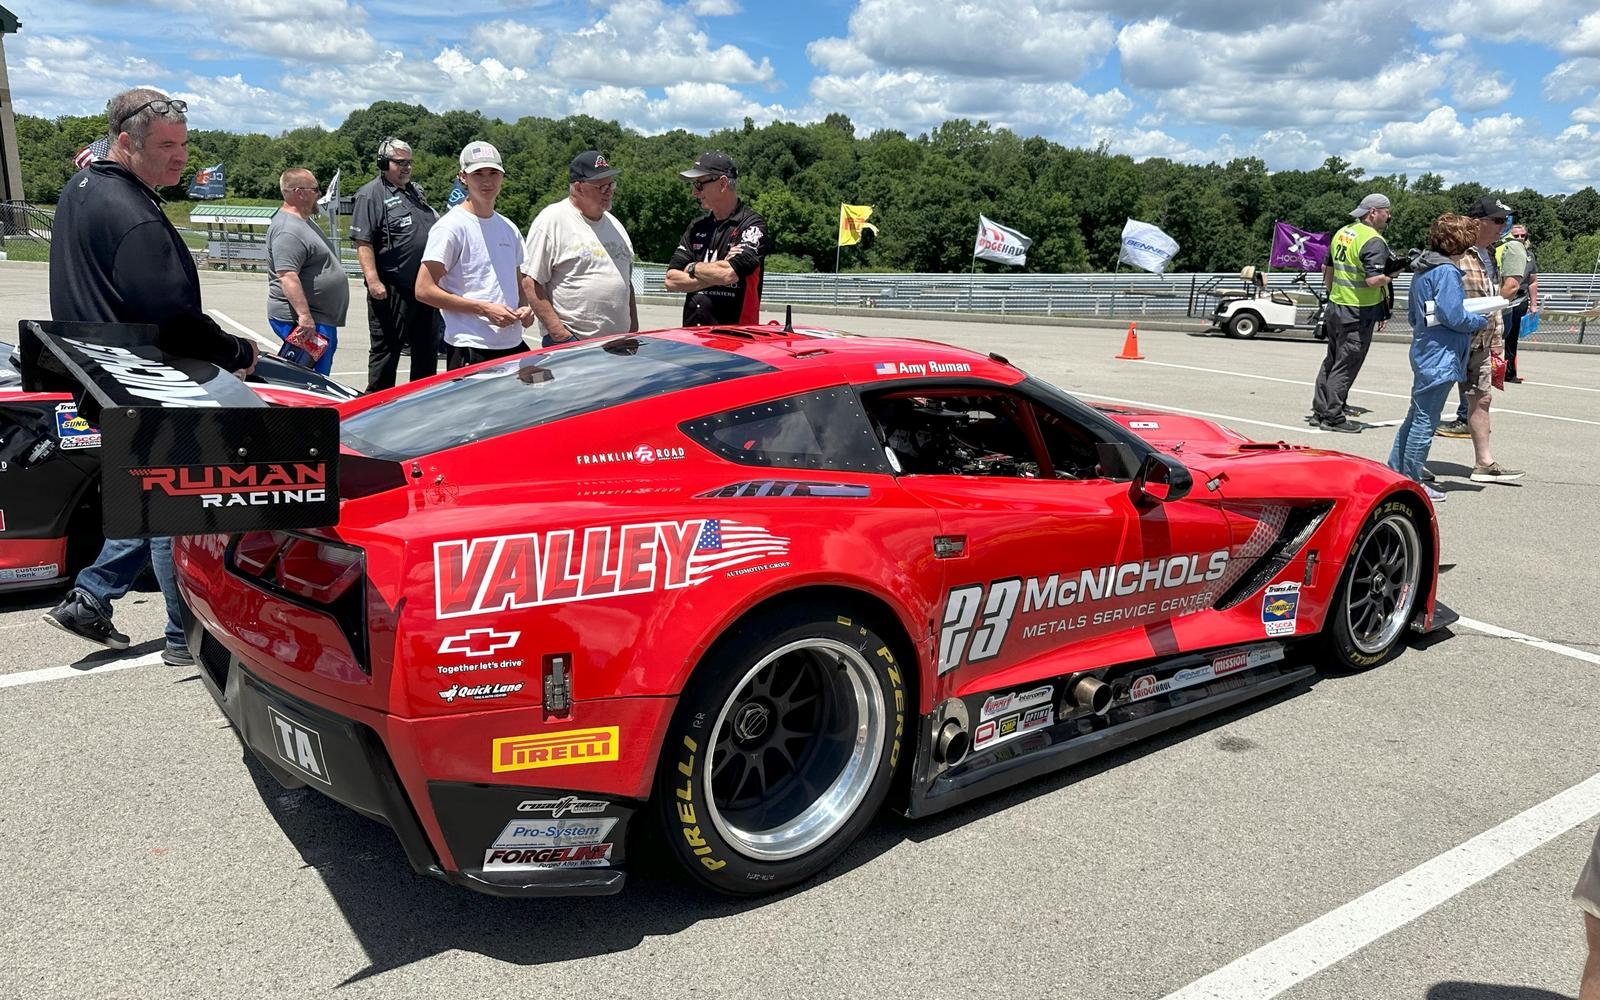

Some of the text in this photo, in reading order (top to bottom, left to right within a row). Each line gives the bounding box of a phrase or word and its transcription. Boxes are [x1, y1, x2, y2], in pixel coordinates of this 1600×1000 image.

[899, 361, 971, 377] Amy Ruman
[576, 450, 634, 465] FRANKLIN
[655, 447, 685, 458] ROAD
[139, 463, 326, 496] RUMAN
[200, 489, 326, 508] RACING
[433, 519, 706, 620] VALLEY
[725, 561, 791, 578] AUTOMOTIVE GROUP
[1022, 550, 1229, 613] McNICHOLS
[1023, 592, 1213, 640] METALS SERVICE CENTER
[437, 659, 522, 675] Together let's drive
[1215, 655, 1247, 672] MISSION
[458, 684, 493, 698] Quick
[492, 682, 523, 694] Lane
[1025, 708, 1049, 723] OPTIMA
[1001, 720, 1017, 732] OMP
[274, 716, 322, 776] TA
[500, 732, 612, 766] PIRELLI
[676, 735, 728, 871] PIRELLI
[513, 826, 599, 838] Pro-System
[487, 845, 610, 865] FORGELINE
